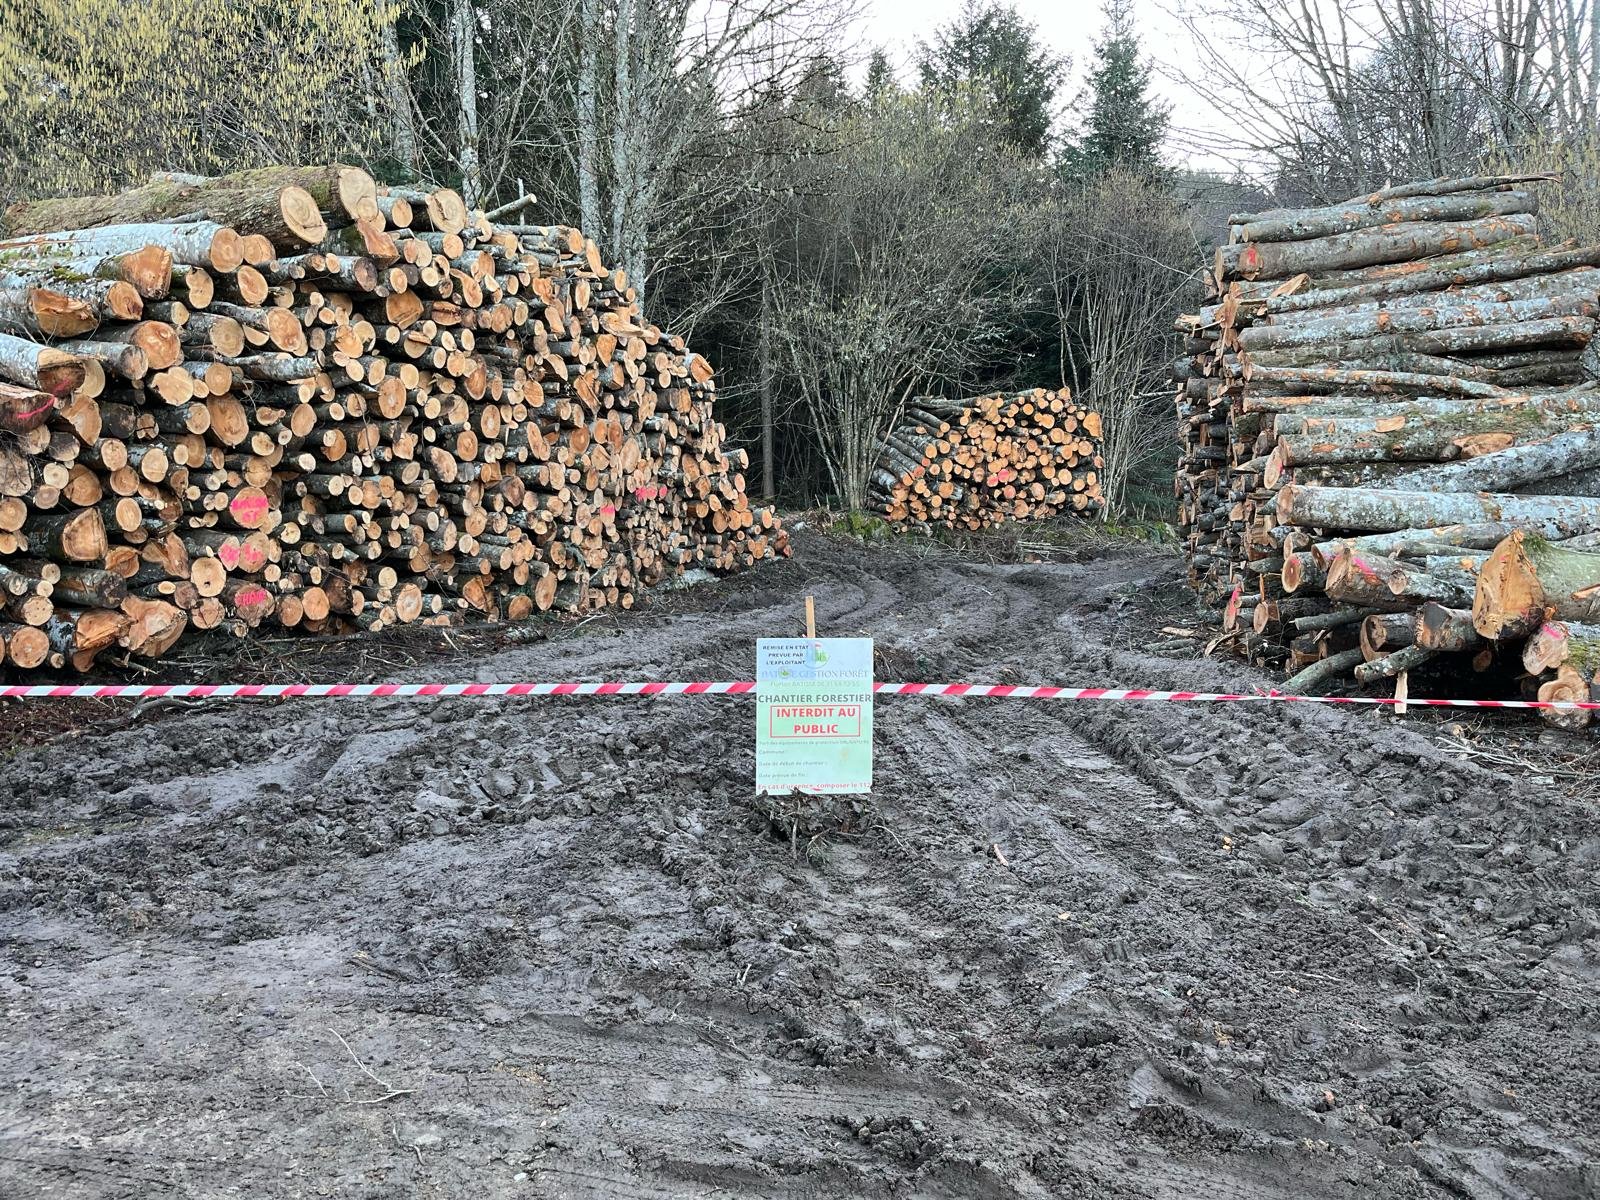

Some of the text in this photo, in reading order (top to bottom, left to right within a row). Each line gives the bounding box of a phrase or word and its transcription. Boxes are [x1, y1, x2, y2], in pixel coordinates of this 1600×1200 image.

[758, 694, 872, 703] CHANTIER FORESTIER
[777, 707, 856, 718] INTERDIT AU
[793, 724, 839, 734] PUBLIC
